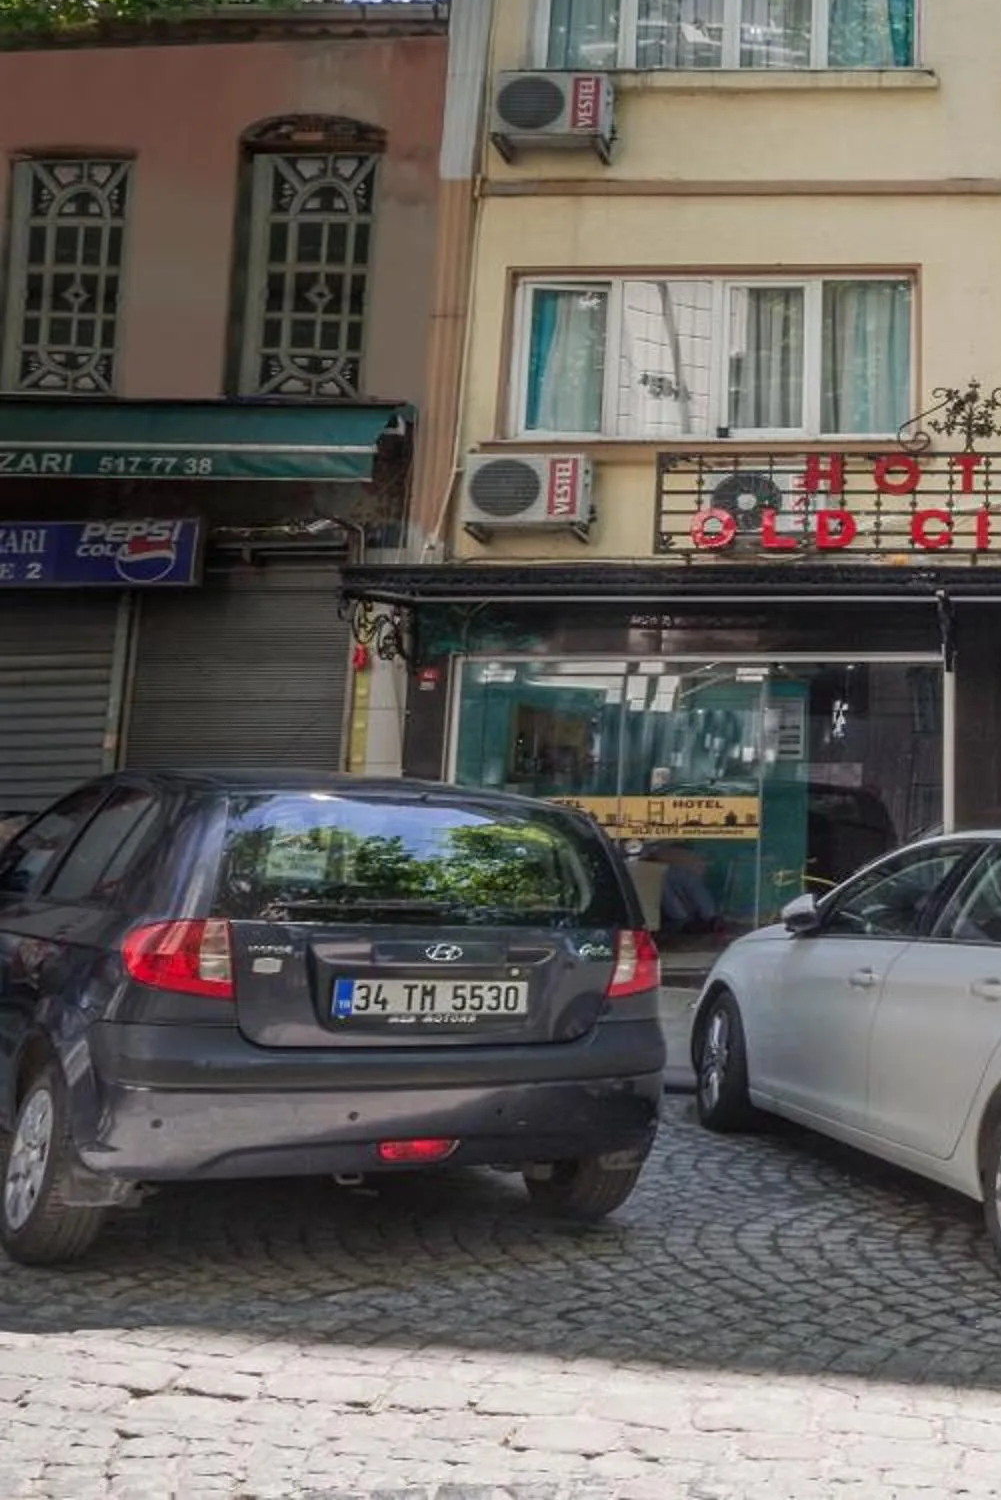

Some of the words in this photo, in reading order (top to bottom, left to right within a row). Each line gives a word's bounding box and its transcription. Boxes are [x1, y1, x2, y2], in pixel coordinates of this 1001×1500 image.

[576, 78, 595, 128] VESTEL
[98, 456, 142, 473] 517
[151, 457, 178, 474] 77
[183, 457, 213, 475] 38
[552, 458, 573, 516] VESTEL
[80, 520, 184, 542] PEPSI
[690, 507, 857, 549] OLD
[25, 561, 43, 580] 2
[672, 799, 724, 809] HOTEL
[354, 984, 389, 1012] 34
[403, 984, 437, 1012] TM
[451, 985, 519, 1012] 5530
